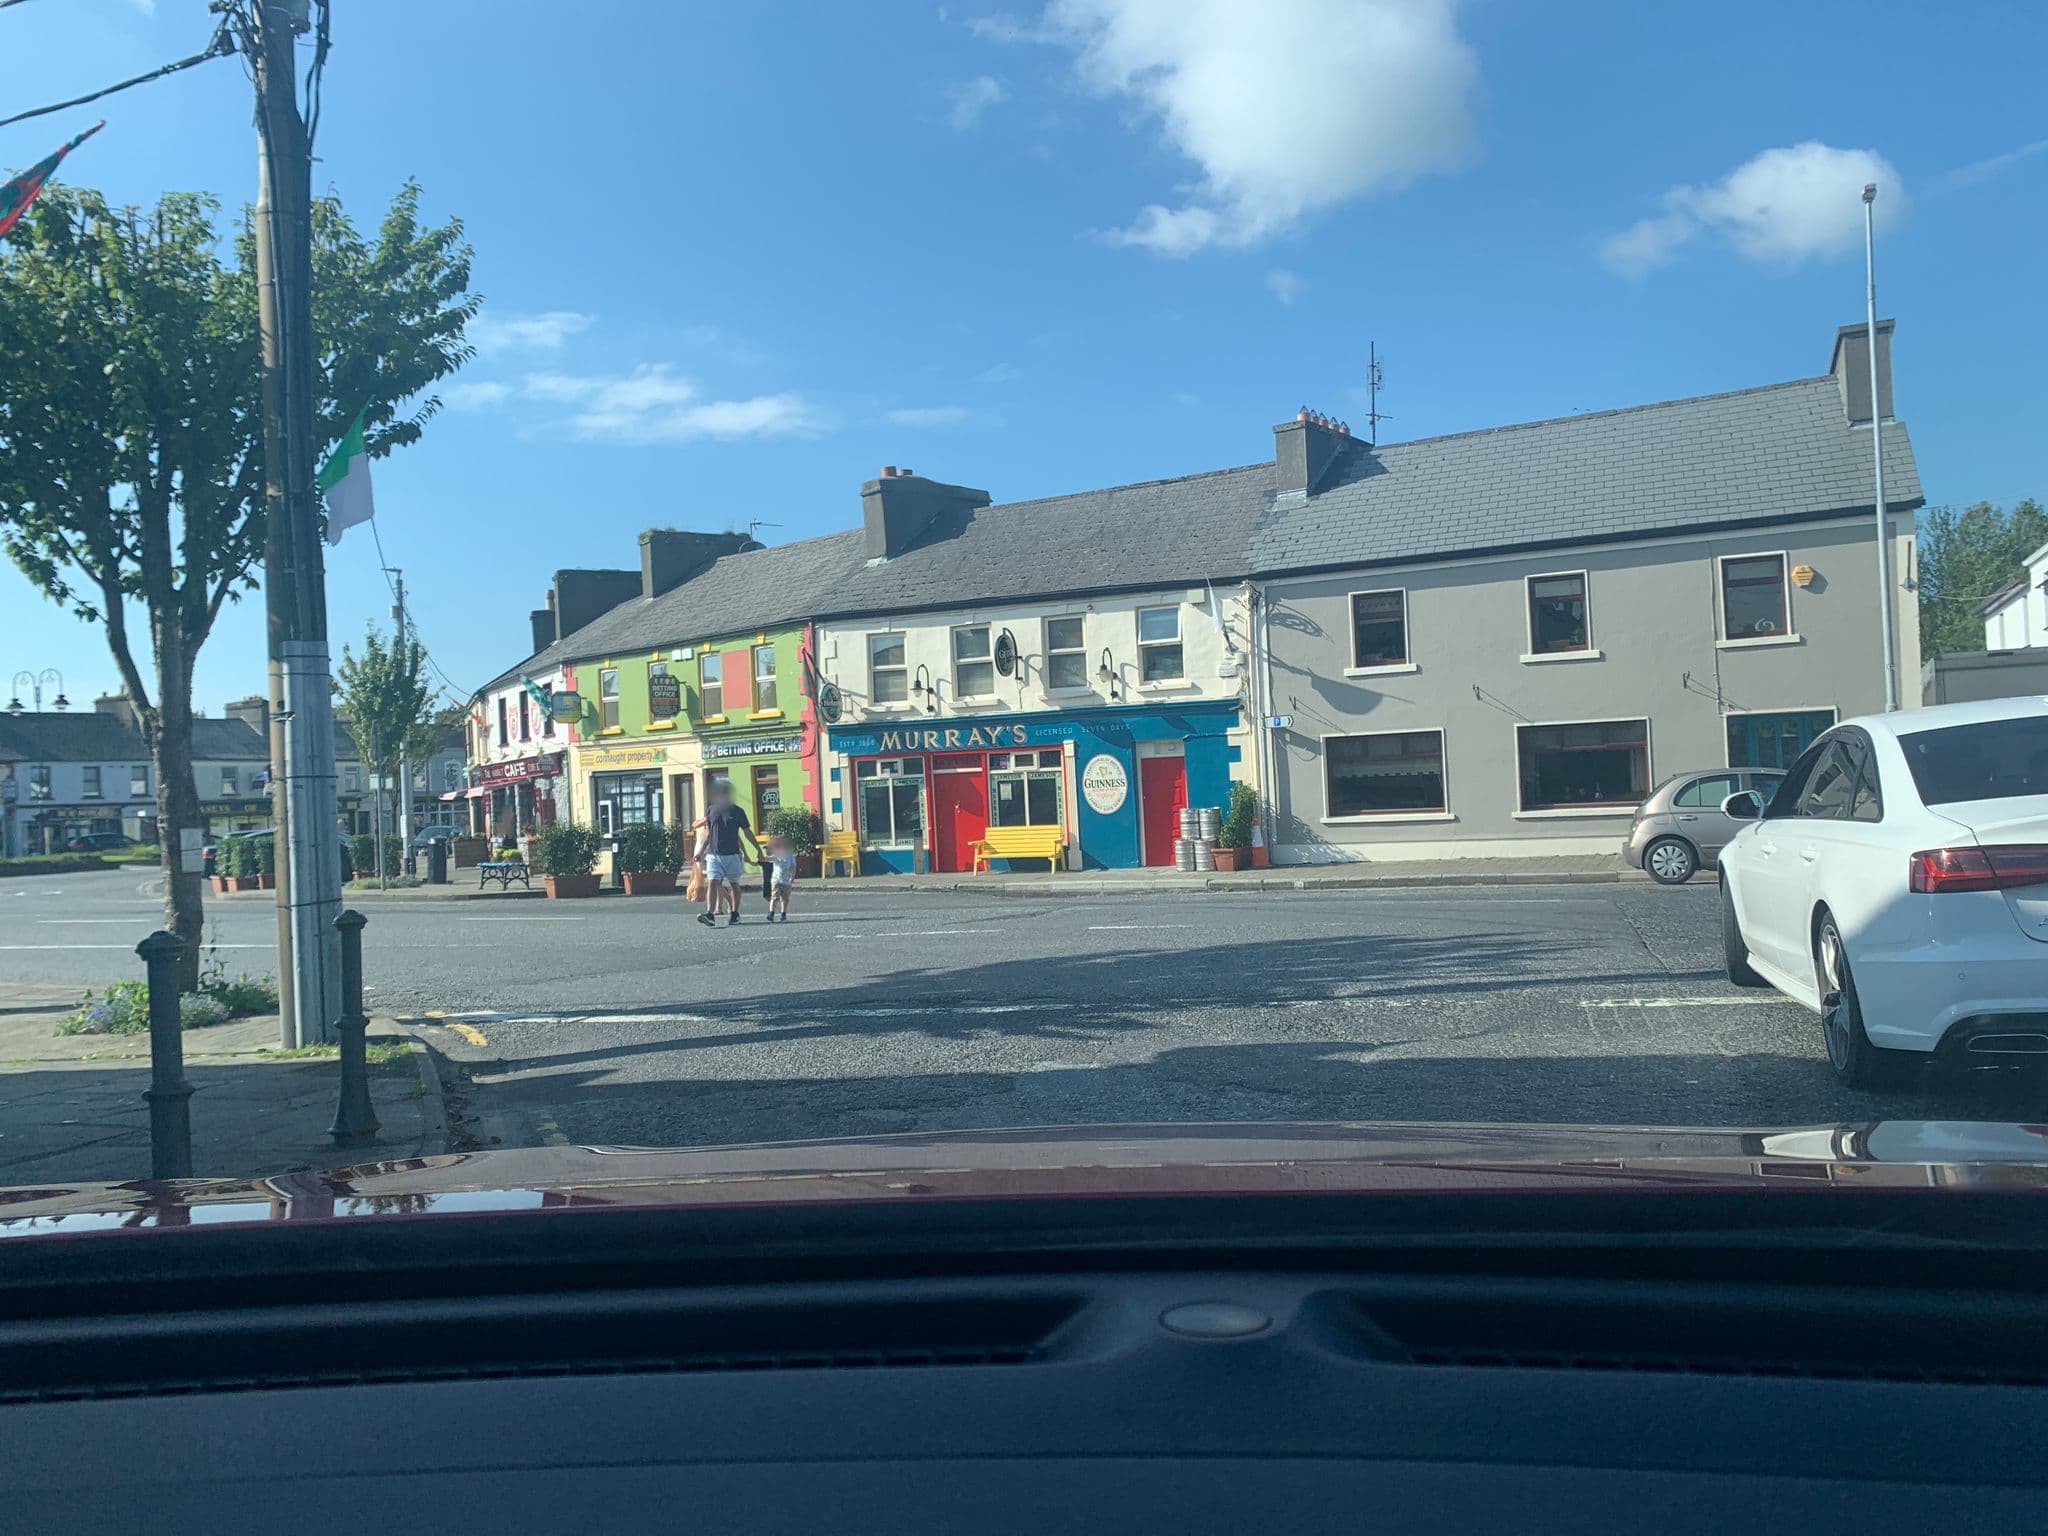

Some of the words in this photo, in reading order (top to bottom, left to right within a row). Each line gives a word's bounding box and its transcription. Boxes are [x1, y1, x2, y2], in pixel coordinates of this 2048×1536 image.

[879, 724, 1027, 751] MURRAY'S
[1035, 728, 1073, 737] LICENSED
[717, 743, 752, 756] BETTING
[754, 740, 785, 753] OFFICE
[504, 763, 527, 777] CAFE
[1084, 778, 1126, 789] GUINNESS
